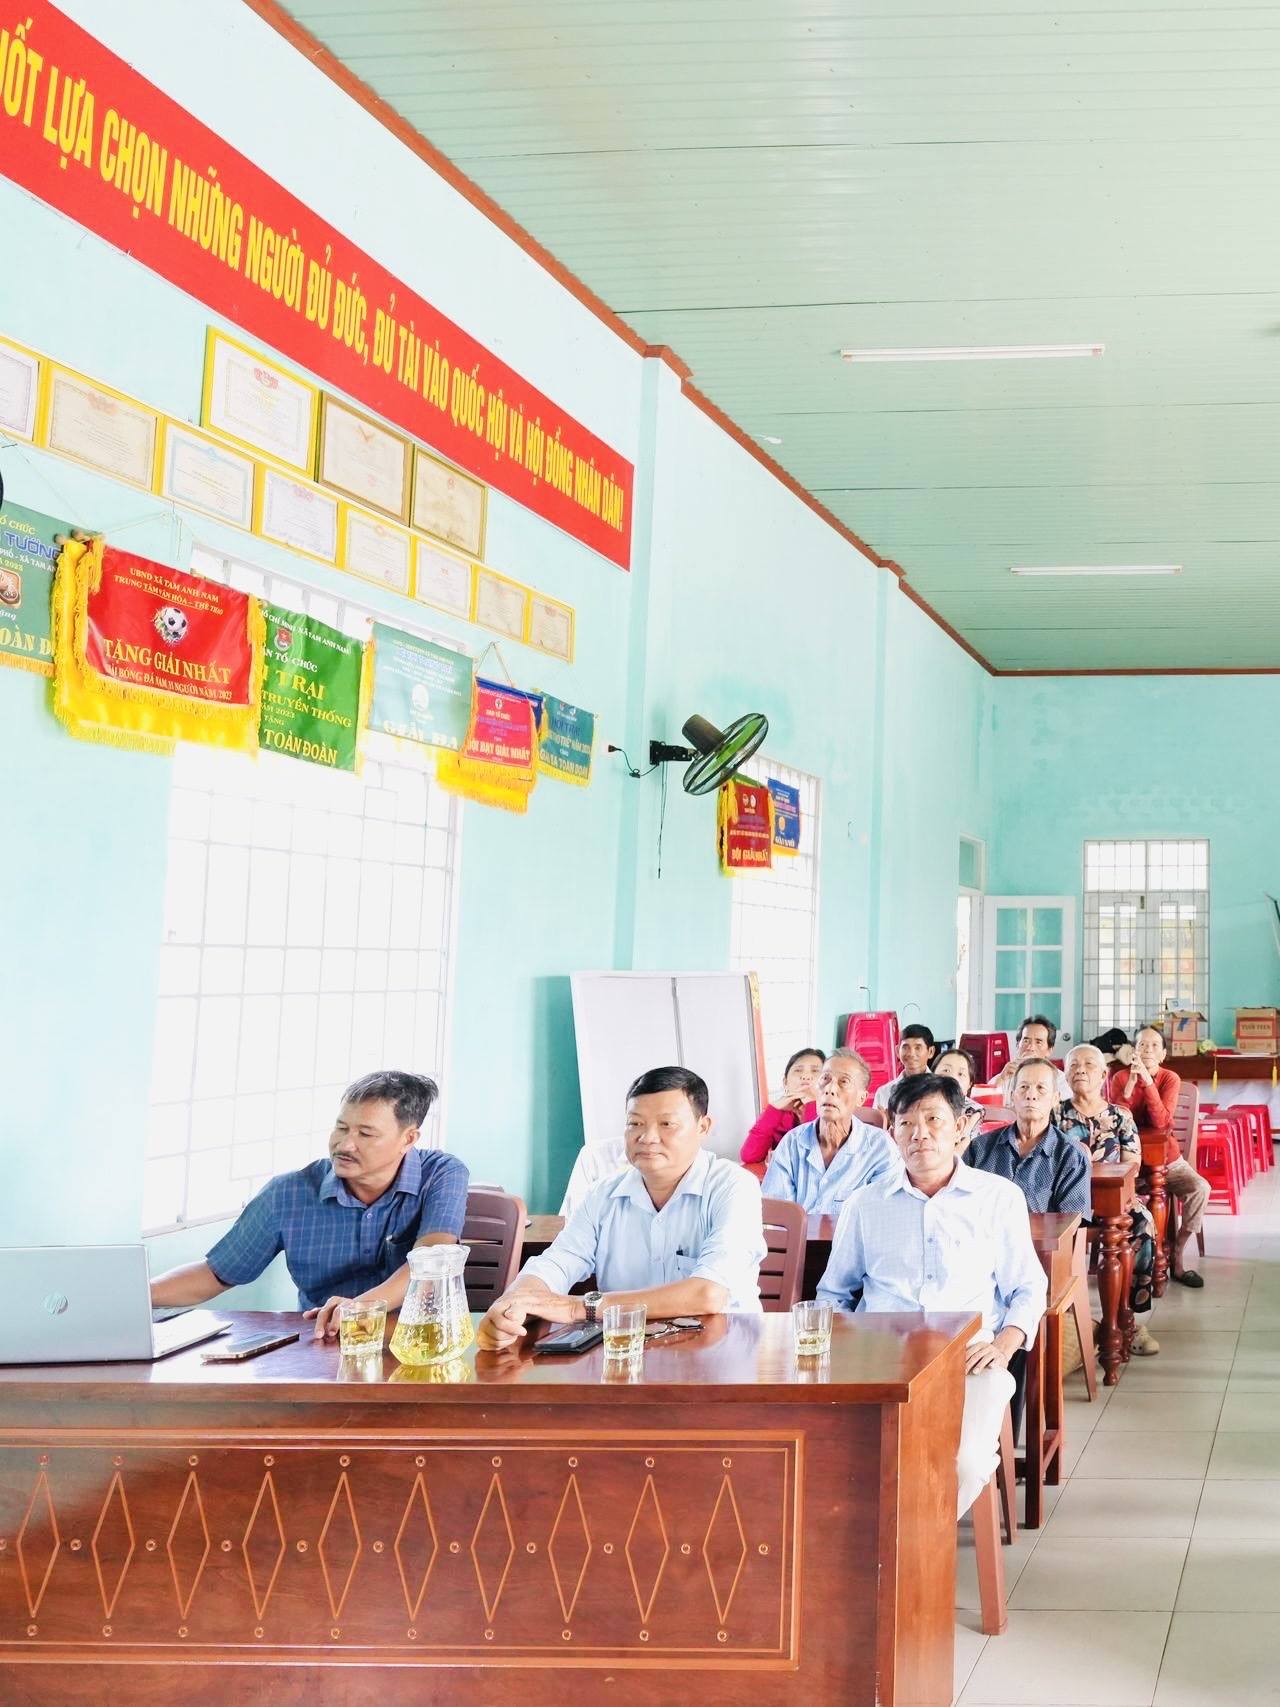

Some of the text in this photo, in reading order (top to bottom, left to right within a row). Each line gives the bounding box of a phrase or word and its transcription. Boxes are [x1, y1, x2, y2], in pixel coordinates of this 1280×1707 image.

[43, 65, 95, 170] LỰA
[100, 109, 168, 220] CHỌN
[168, 158, 244, 271] NHỮNG
[245, 214, 304, 313] NGƯỜI
[305, 244, 332, 330] ĐỦ
[332, 272, 368, 366] ĐỨC,
[373, 293, 396, 375] ĐỦ
[398, 320, 421, 393] TÀI
[423, 340, 449, 412] VÀO
[451, 363, 485, 437] QUỐC
[486, 389, 507, 461] HỘI
[509, 403, 523, 465] VÀ
[525, 416, 545, 486] HỘI
[545, 426, 574, 498] ĐỒNG
[574, 457, 602, 516] NHÂN
[114, 575, 142, 588] TRUNG
[143, 583, 159, 595] TÂM
[130, 568, 219, 603] UBND XÃ TAM ANH NAM
[0, 624, 35, 651] OÀN
[104, 638, 152, 666] TẶNG
[154, 651, 180, 677] GIẢI
[182, 660, 231, 684] NHẤT
[118, 665, 143, 681] BÓNG
[144, 672, 154, 684] ĐÁ
[275, 670, 327, 700] TRẠI
[261, 689, 352, 728] TRUYỀN THỐNG
[263, 729, 338, 765] TOÀN ĐOÀN
